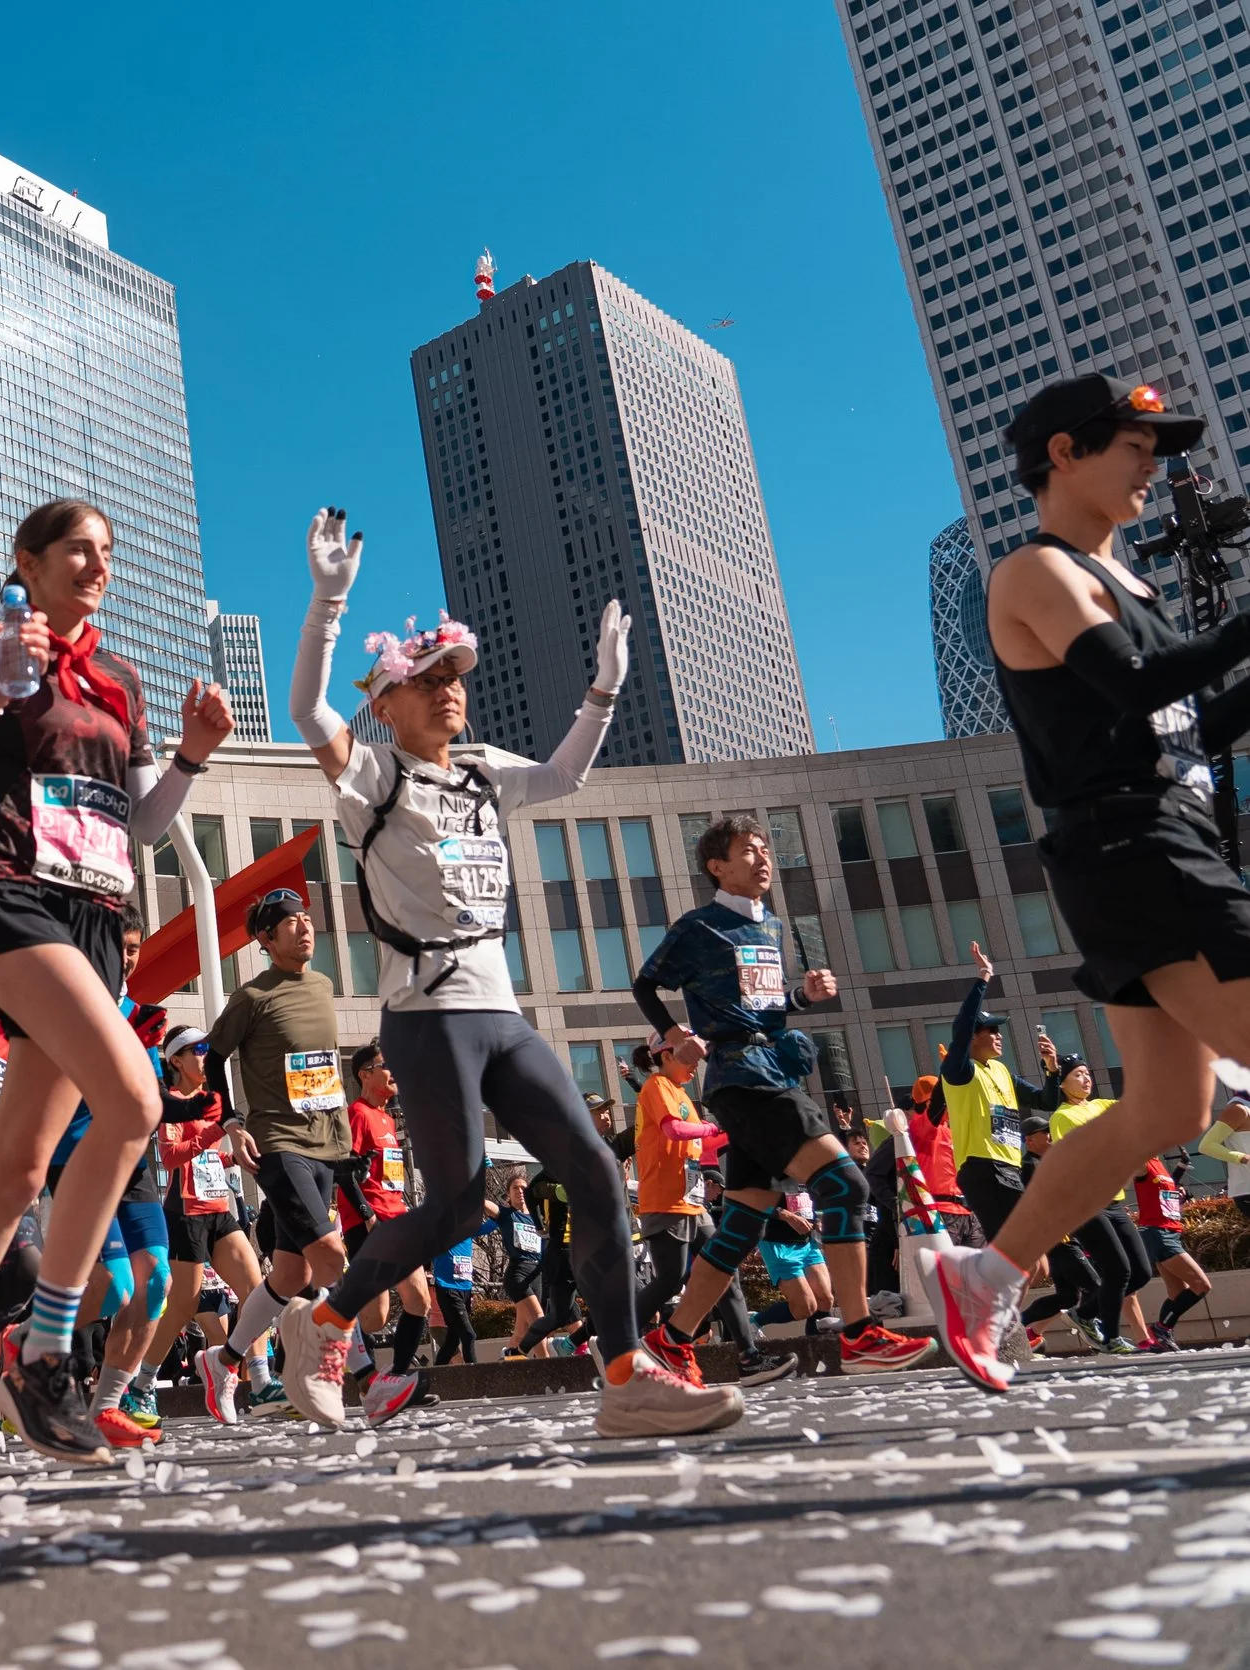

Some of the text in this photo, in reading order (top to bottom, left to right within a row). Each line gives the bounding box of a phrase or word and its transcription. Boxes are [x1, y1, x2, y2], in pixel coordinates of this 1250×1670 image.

[78, 786, 128, 816] 東京メトロ
[443, 868, 456, 885] E
[741, 968, 750, 979] E
[992, 1117, 999, 1125] D
